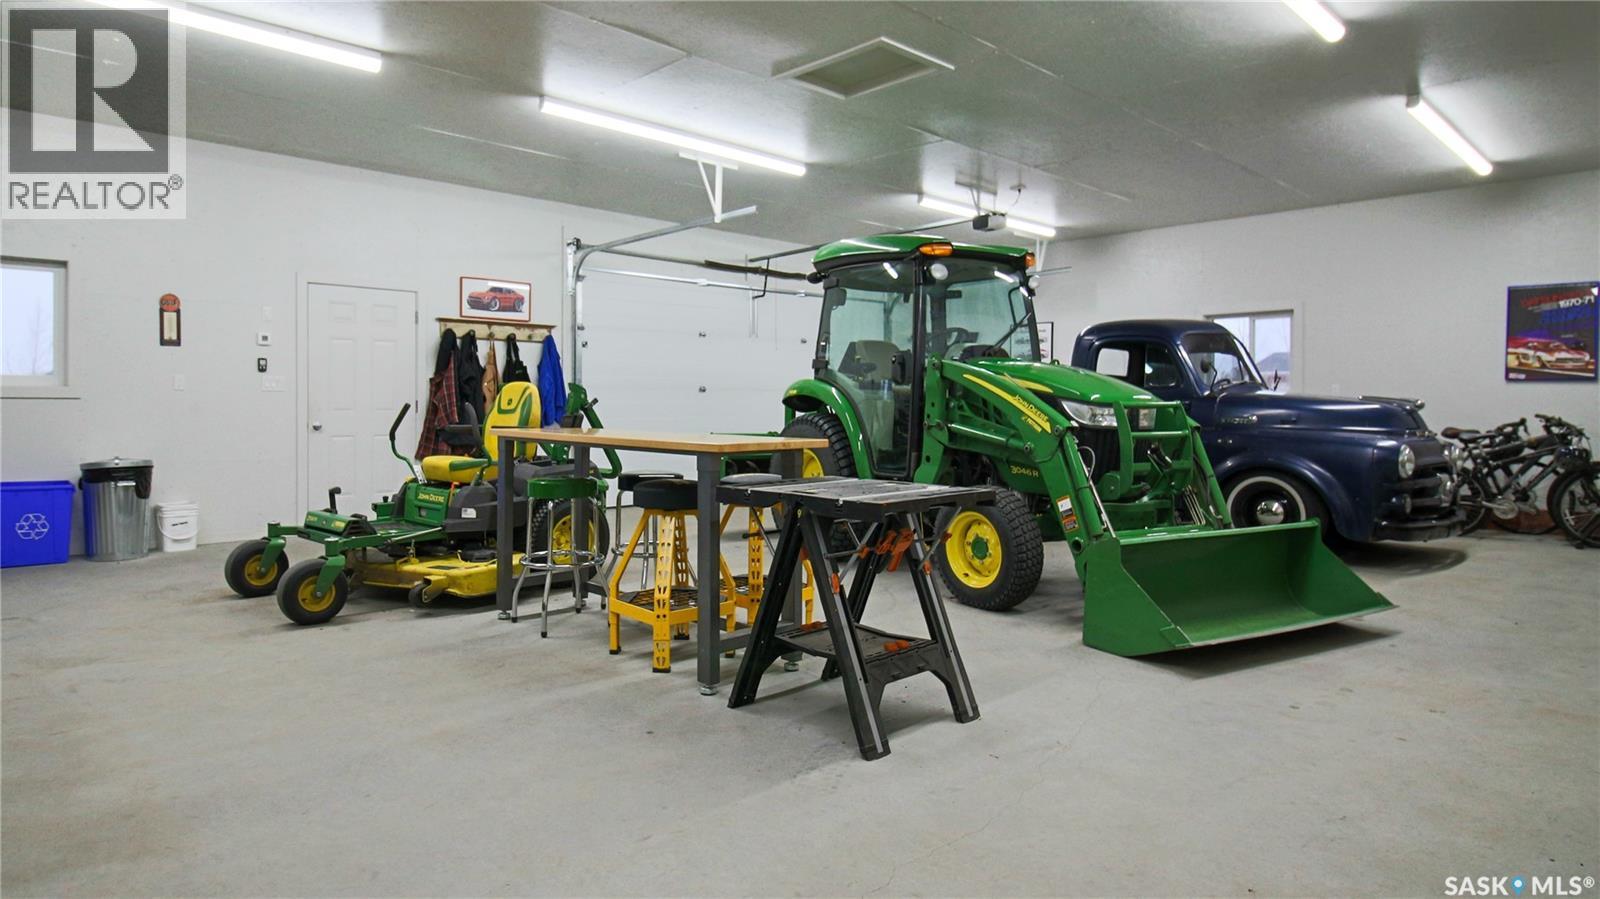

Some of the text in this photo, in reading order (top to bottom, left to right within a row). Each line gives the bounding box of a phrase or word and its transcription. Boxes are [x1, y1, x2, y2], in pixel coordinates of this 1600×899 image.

[1015, 394, 1049, 422] JOHN DEERE
[417, 492, 445, 503] JOHN DEERE
